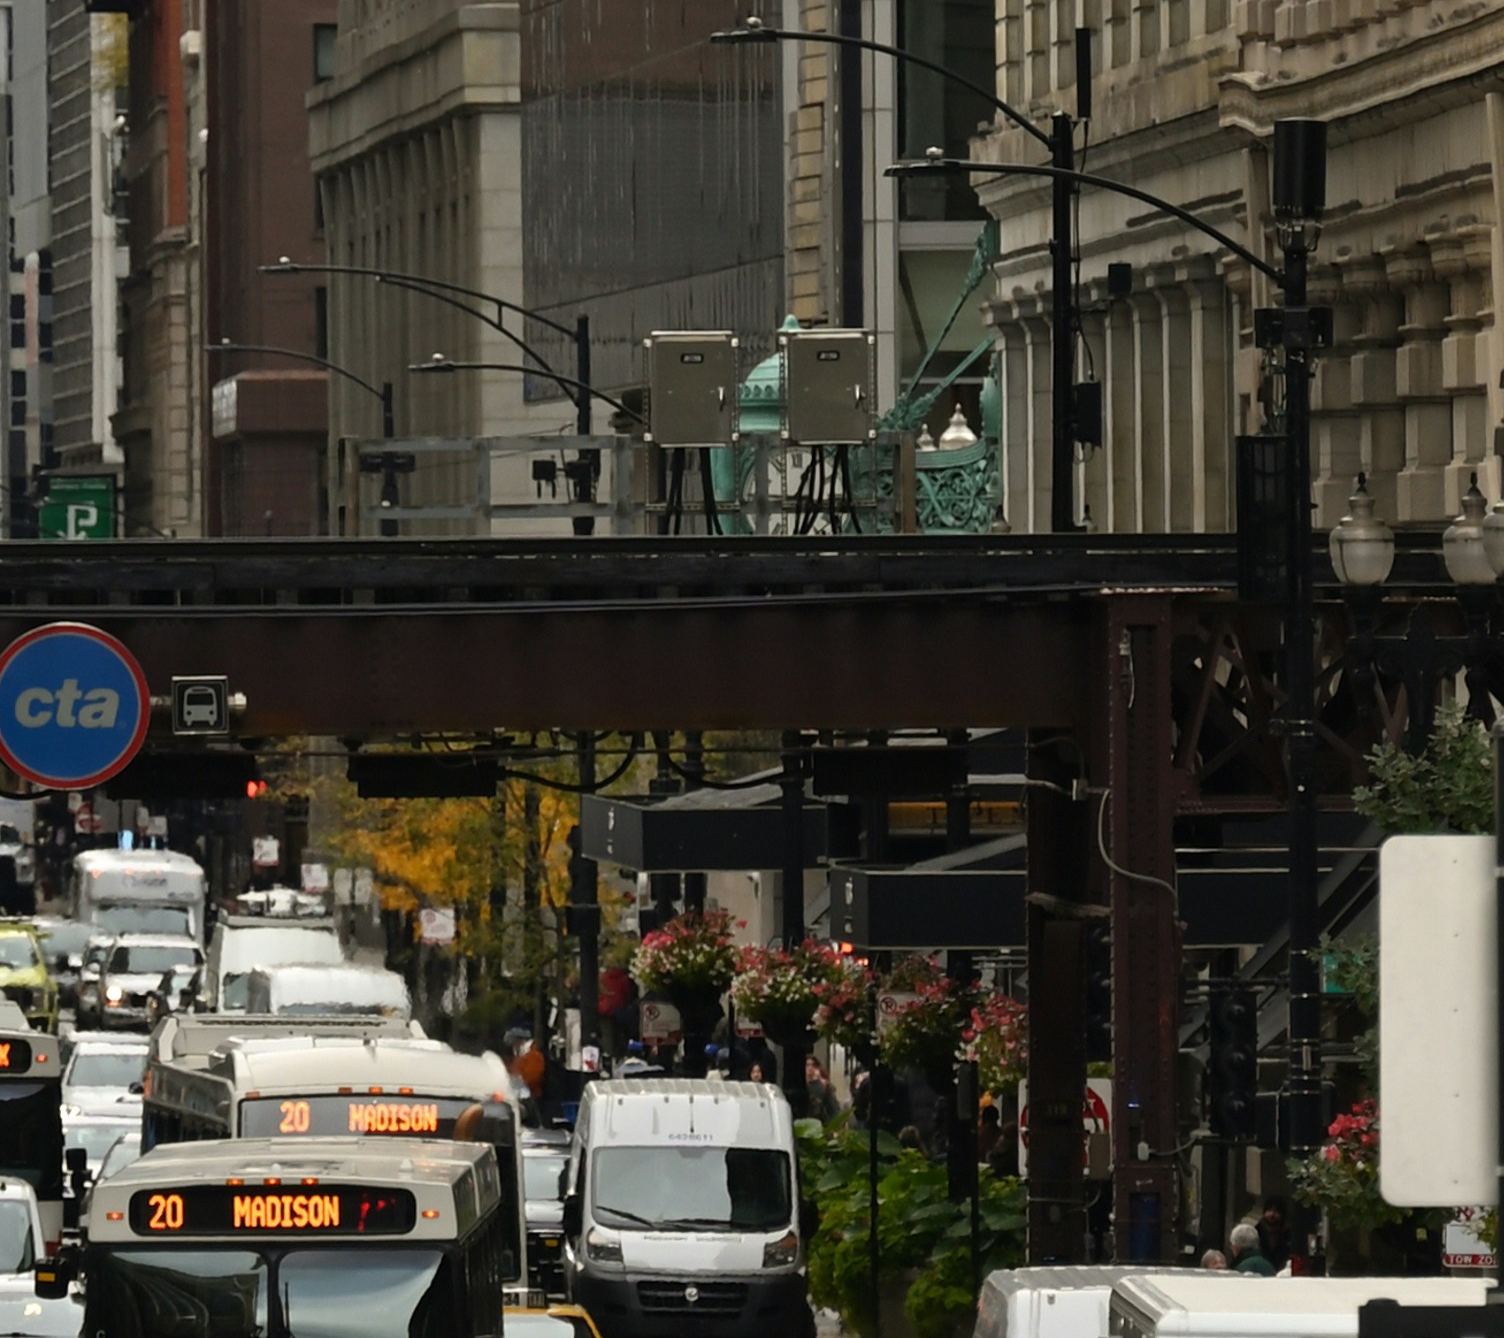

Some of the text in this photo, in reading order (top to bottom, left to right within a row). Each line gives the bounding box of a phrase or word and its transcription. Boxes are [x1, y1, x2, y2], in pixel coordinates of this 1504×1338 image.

[14, 678, 120, 729] cta
[279, 1101, 438, 1133] 20 MADISON
[148, 1194, 340, 1229] 20 MADISON
